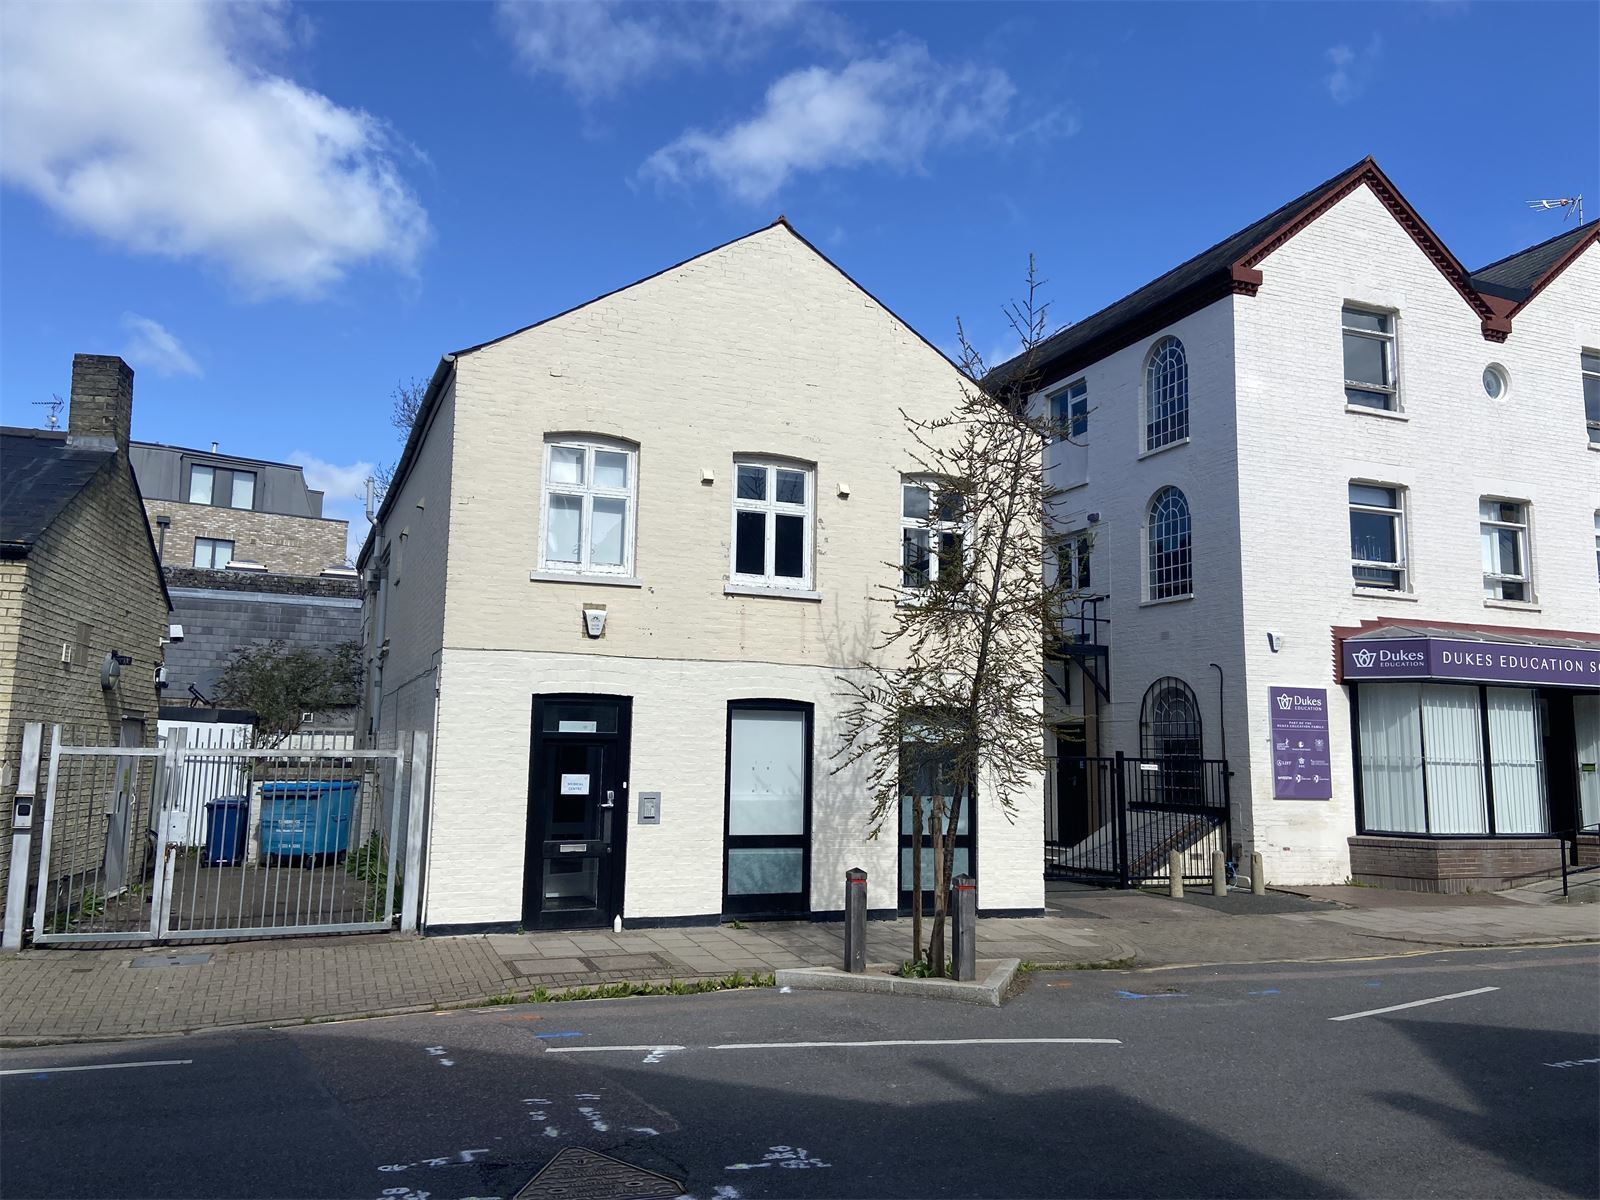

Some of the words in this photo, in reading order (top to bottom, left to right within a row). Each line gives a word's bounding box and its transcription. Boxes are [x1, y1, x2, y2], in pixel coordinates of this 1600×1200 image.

[1379, 649, 1424, 661] Dukes
[1442, 651, 1493, 667] DUKES
[1500, 655, 1584, 672] EDUCATION
[1294, 695, 1322, 706] Dukes
